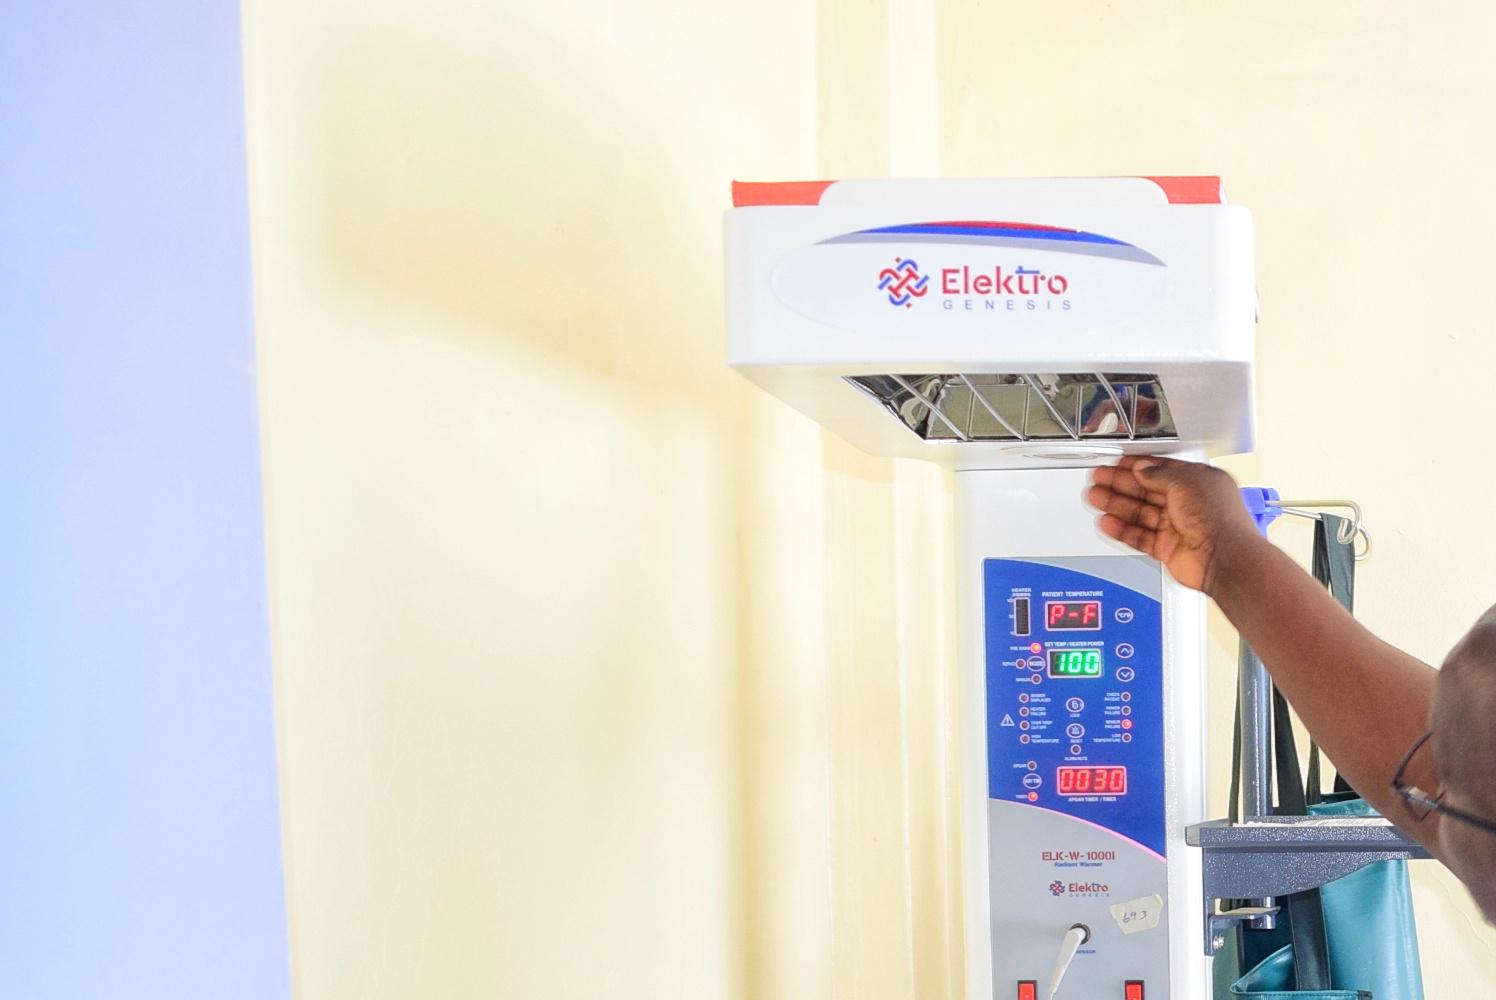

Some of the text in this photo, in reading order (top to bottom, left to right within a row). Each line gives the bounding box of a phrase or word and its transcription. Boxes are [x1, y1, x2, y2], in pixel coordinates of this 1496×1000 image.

[941, 264, 1069, 296] Elektro
[942, 299, 1071, 311] GENESIS
[1058, 652, 1100, 673] 100
[1060, 769, 1124, 791] 0030
[1069, 882, 1108, 892] Elektro
